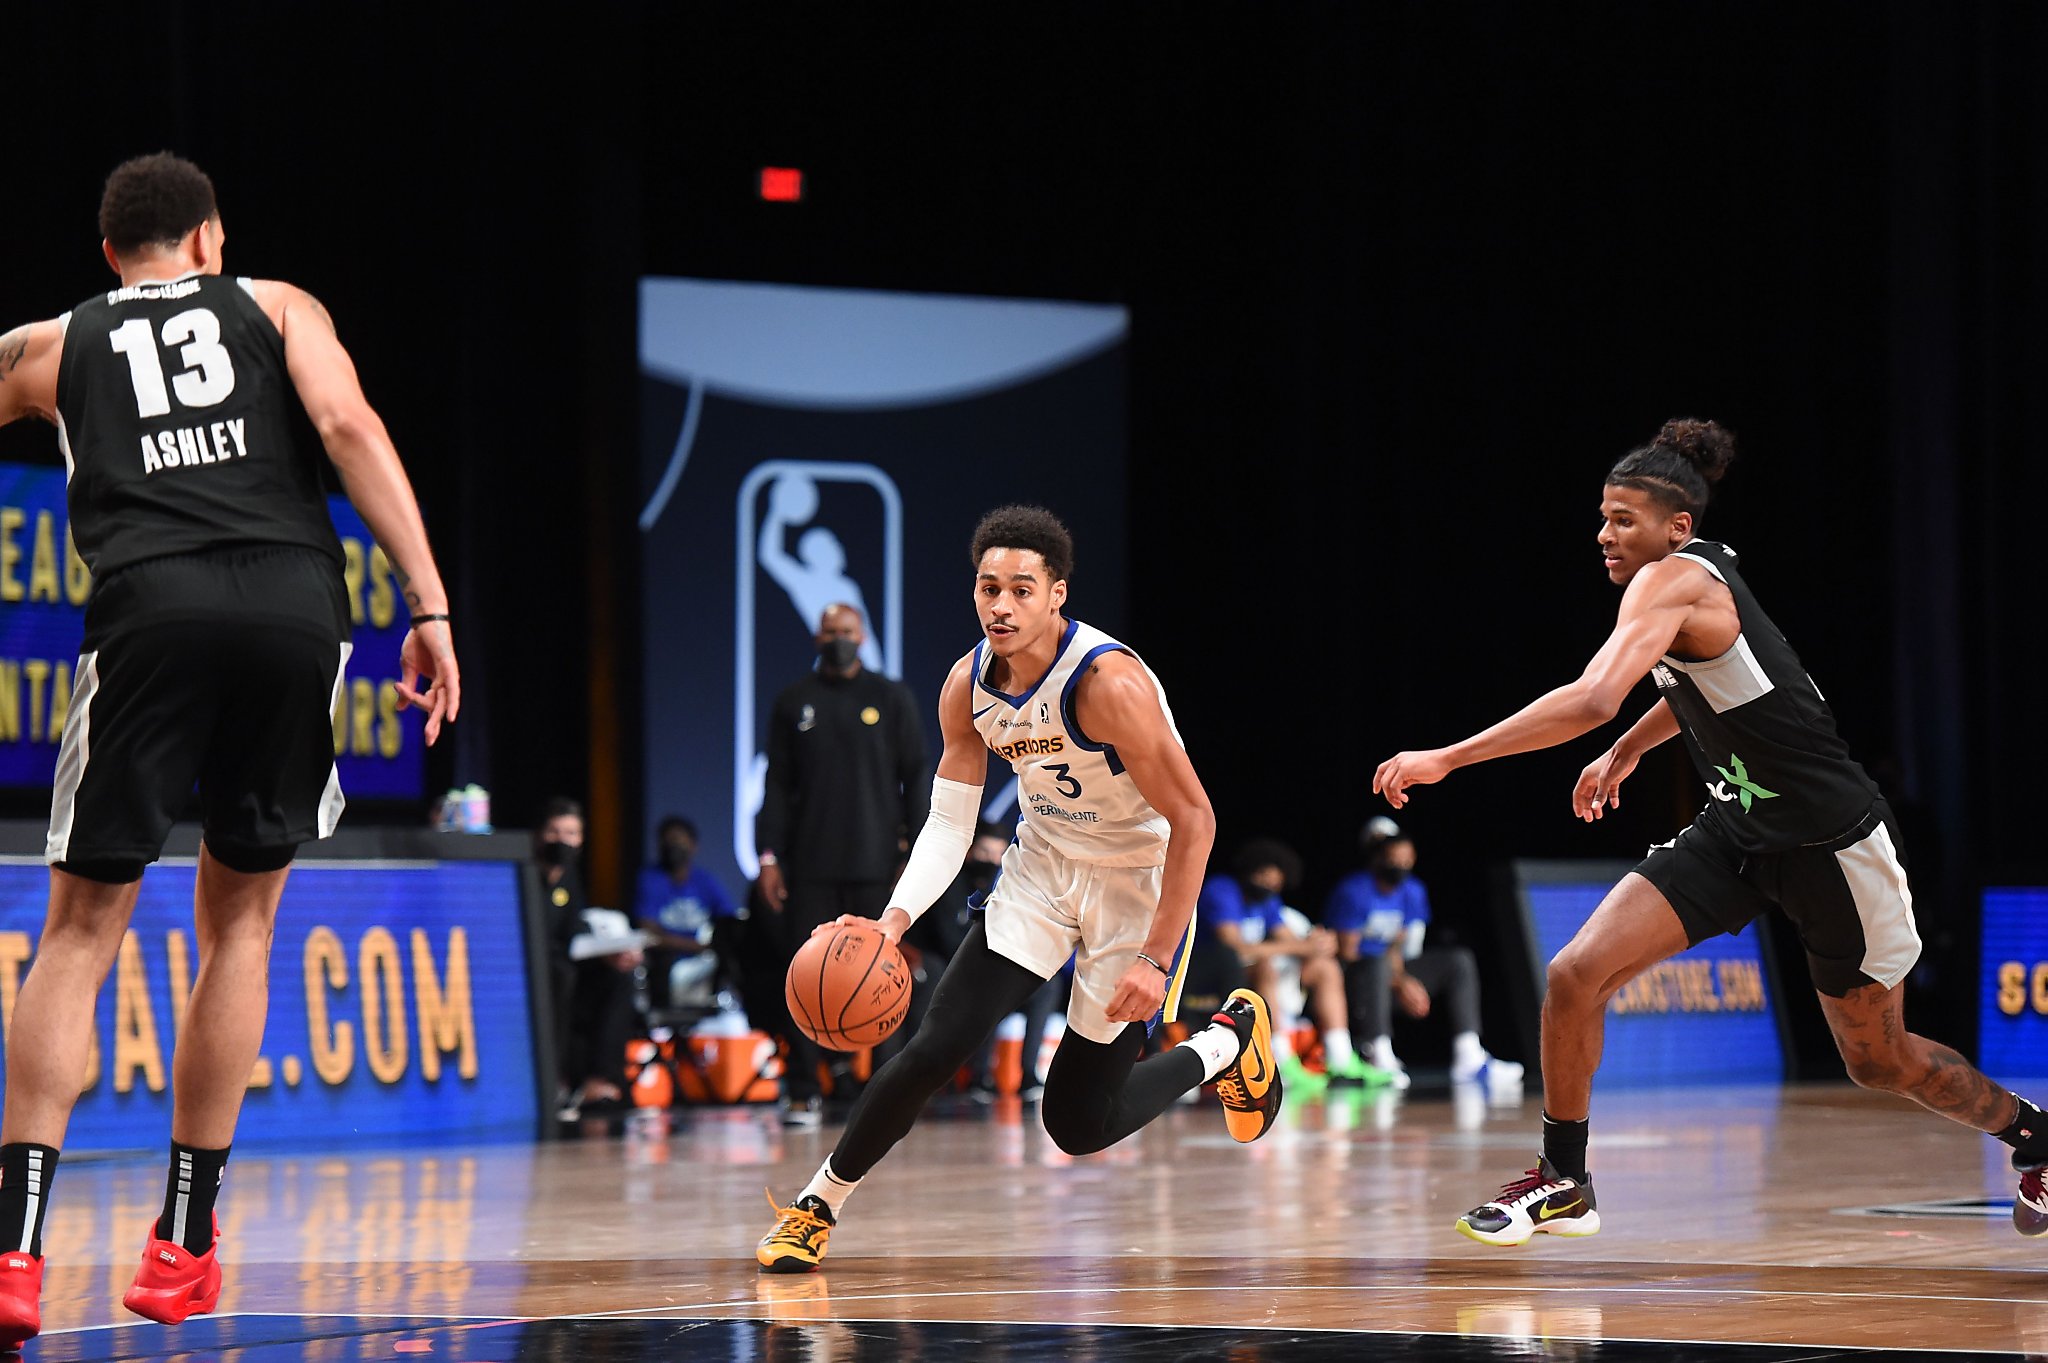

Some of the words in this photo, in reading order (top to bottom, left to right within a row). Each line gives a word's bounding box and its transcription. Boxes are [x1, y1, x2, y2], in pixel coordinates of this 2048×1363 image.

[109, 308, 236, 418] 13
[139, 418, 249, 474] ASHLEY
[990, 736, 1065, 761] ARRIORS
[1041, 763, 1082, 799] 3
